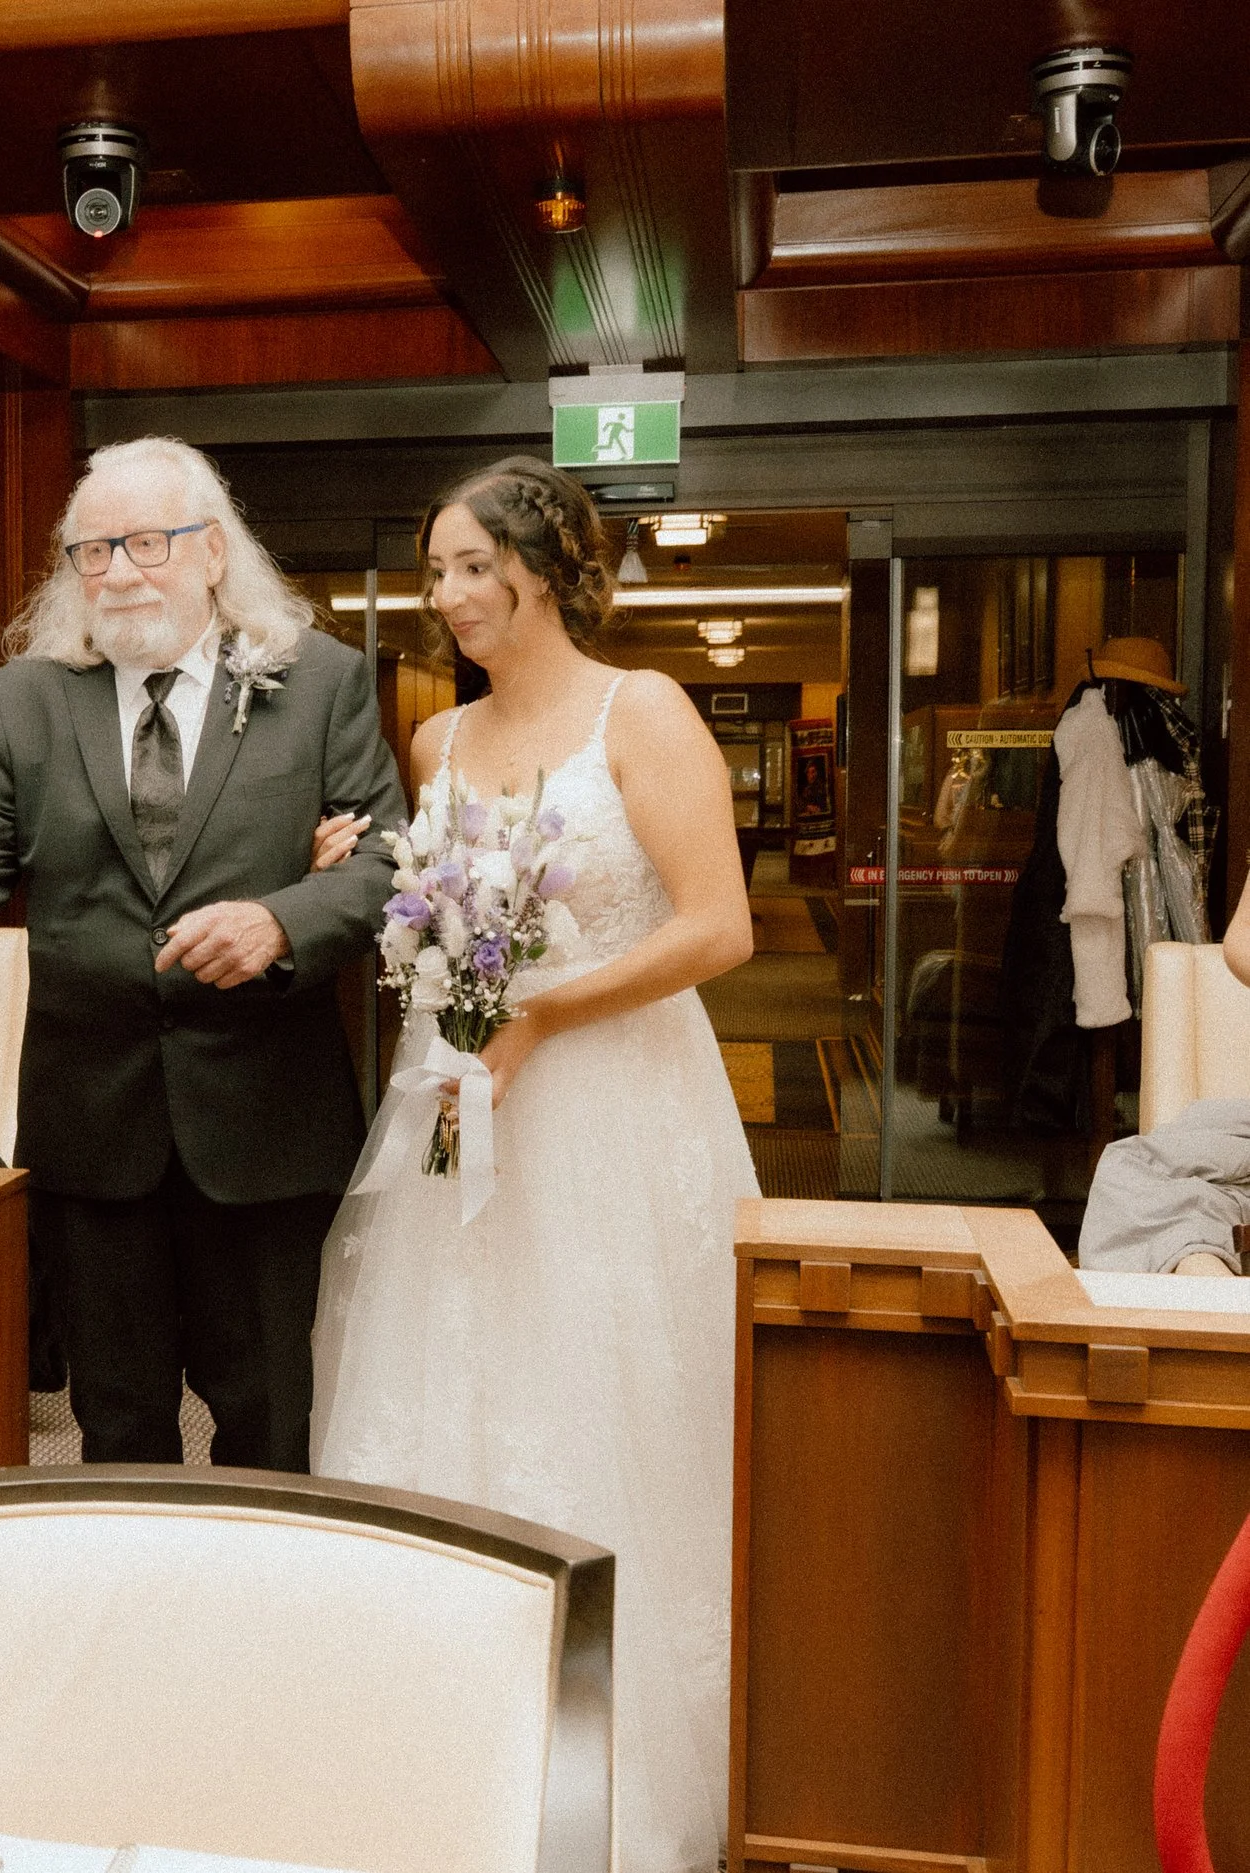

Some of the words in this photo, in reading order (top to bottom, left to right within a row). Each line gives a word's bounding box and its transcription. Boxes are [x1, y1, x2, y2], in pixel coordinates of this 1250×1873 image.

[965, 734, 994, 744] CAUTION
[999, 734, 1037, 744] AUTOMATIC
[867, 870, 877, 880] IN
[880, 870, 934, 881] ERGENCY
[936, 870, 961, 881] PUSH
[963, 870, 975, 881] TO
[977, 870, 1002, 881] OPEN
